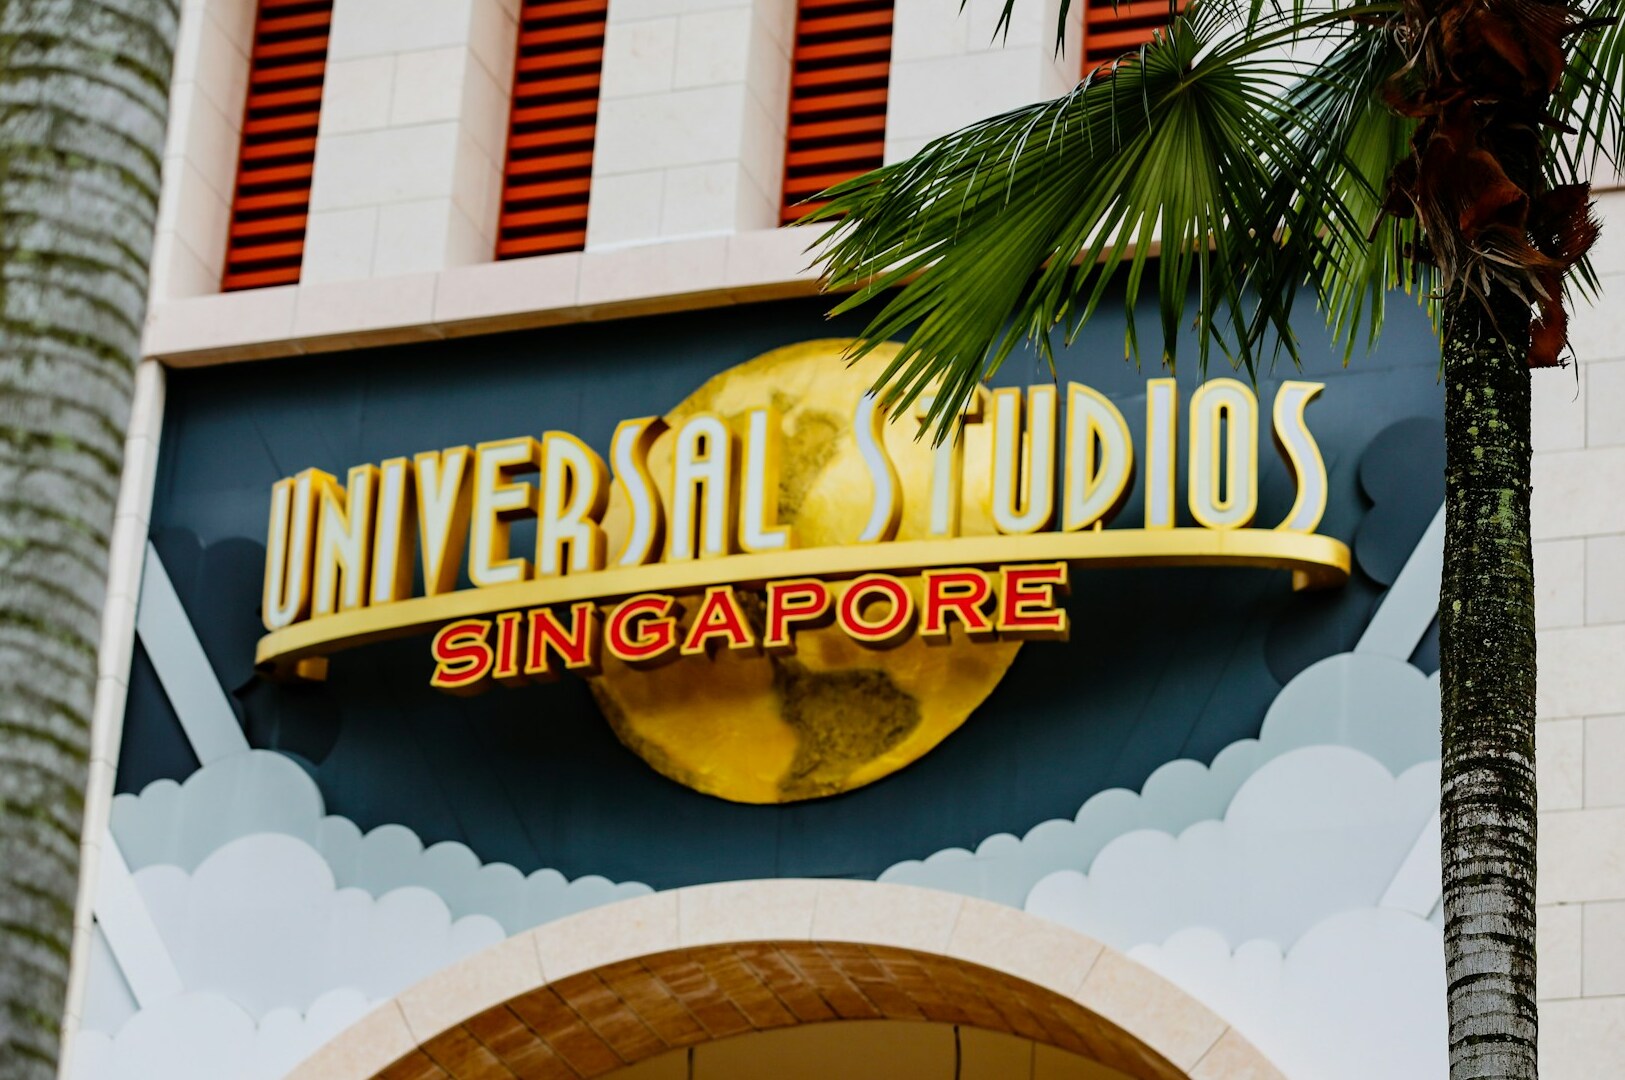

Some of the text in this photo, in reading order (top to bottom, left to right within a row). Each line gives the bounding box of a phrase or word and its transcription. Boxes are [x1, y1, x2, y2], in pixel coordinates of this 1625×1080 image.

[262, 378, 1328, 632] UNIVERSAL STUDIOS
[430, 562, 1069, 688] SINGAPORE
